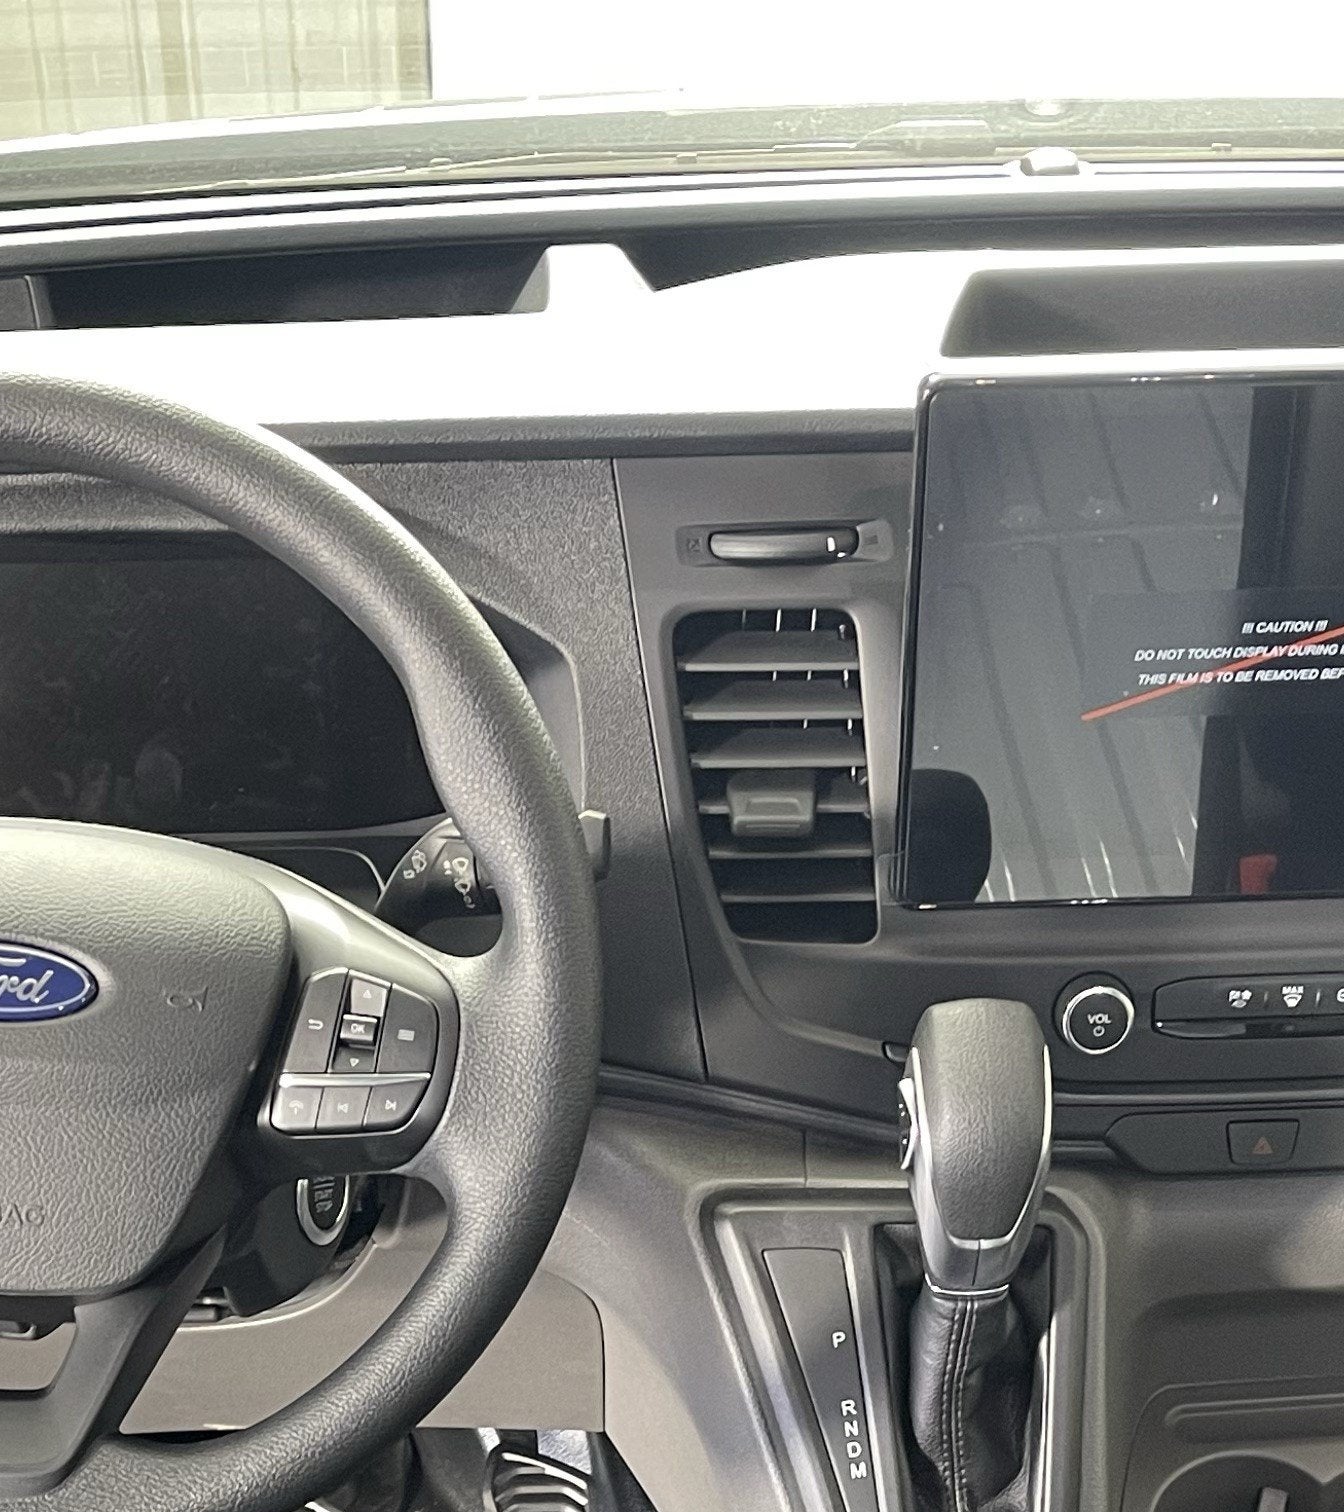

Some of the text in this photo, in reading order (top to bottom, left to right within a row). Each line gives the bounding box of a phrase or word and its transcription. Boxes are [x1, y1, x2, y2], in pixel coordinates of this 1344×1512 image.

[1256, 620, 1315, 633] CAUTION
[1134, 649, 1155, 662] DO
[1156, 648, 1184, 661] NOT
[1187, 646, 1232, 660] TOUCH
[1233, 645, 1289, 659] DISPLAY
[1287, 643, 1339, 657] DURING
[1138, 673, 1167, 686] THIS
[1168, 672, 1199, 685] FILM
[1199, 671, 1214, 684] IS
[1216, 671, 1233, 683] TO
[1234, 670, 1255, 683] BE
[1255, 668, 1320, 682] REMOVED
[1087, 1013, 1111, 1025] VOL
[350, 1023, 366, 1034] OK
[831, 1331, 846, 1348] P
[840, 1399, 857, 1416] R
[843, 1420, 859, 1437] N
[846, 1441, 862, 1459] D
[849, 1462, 868, 1480] M
